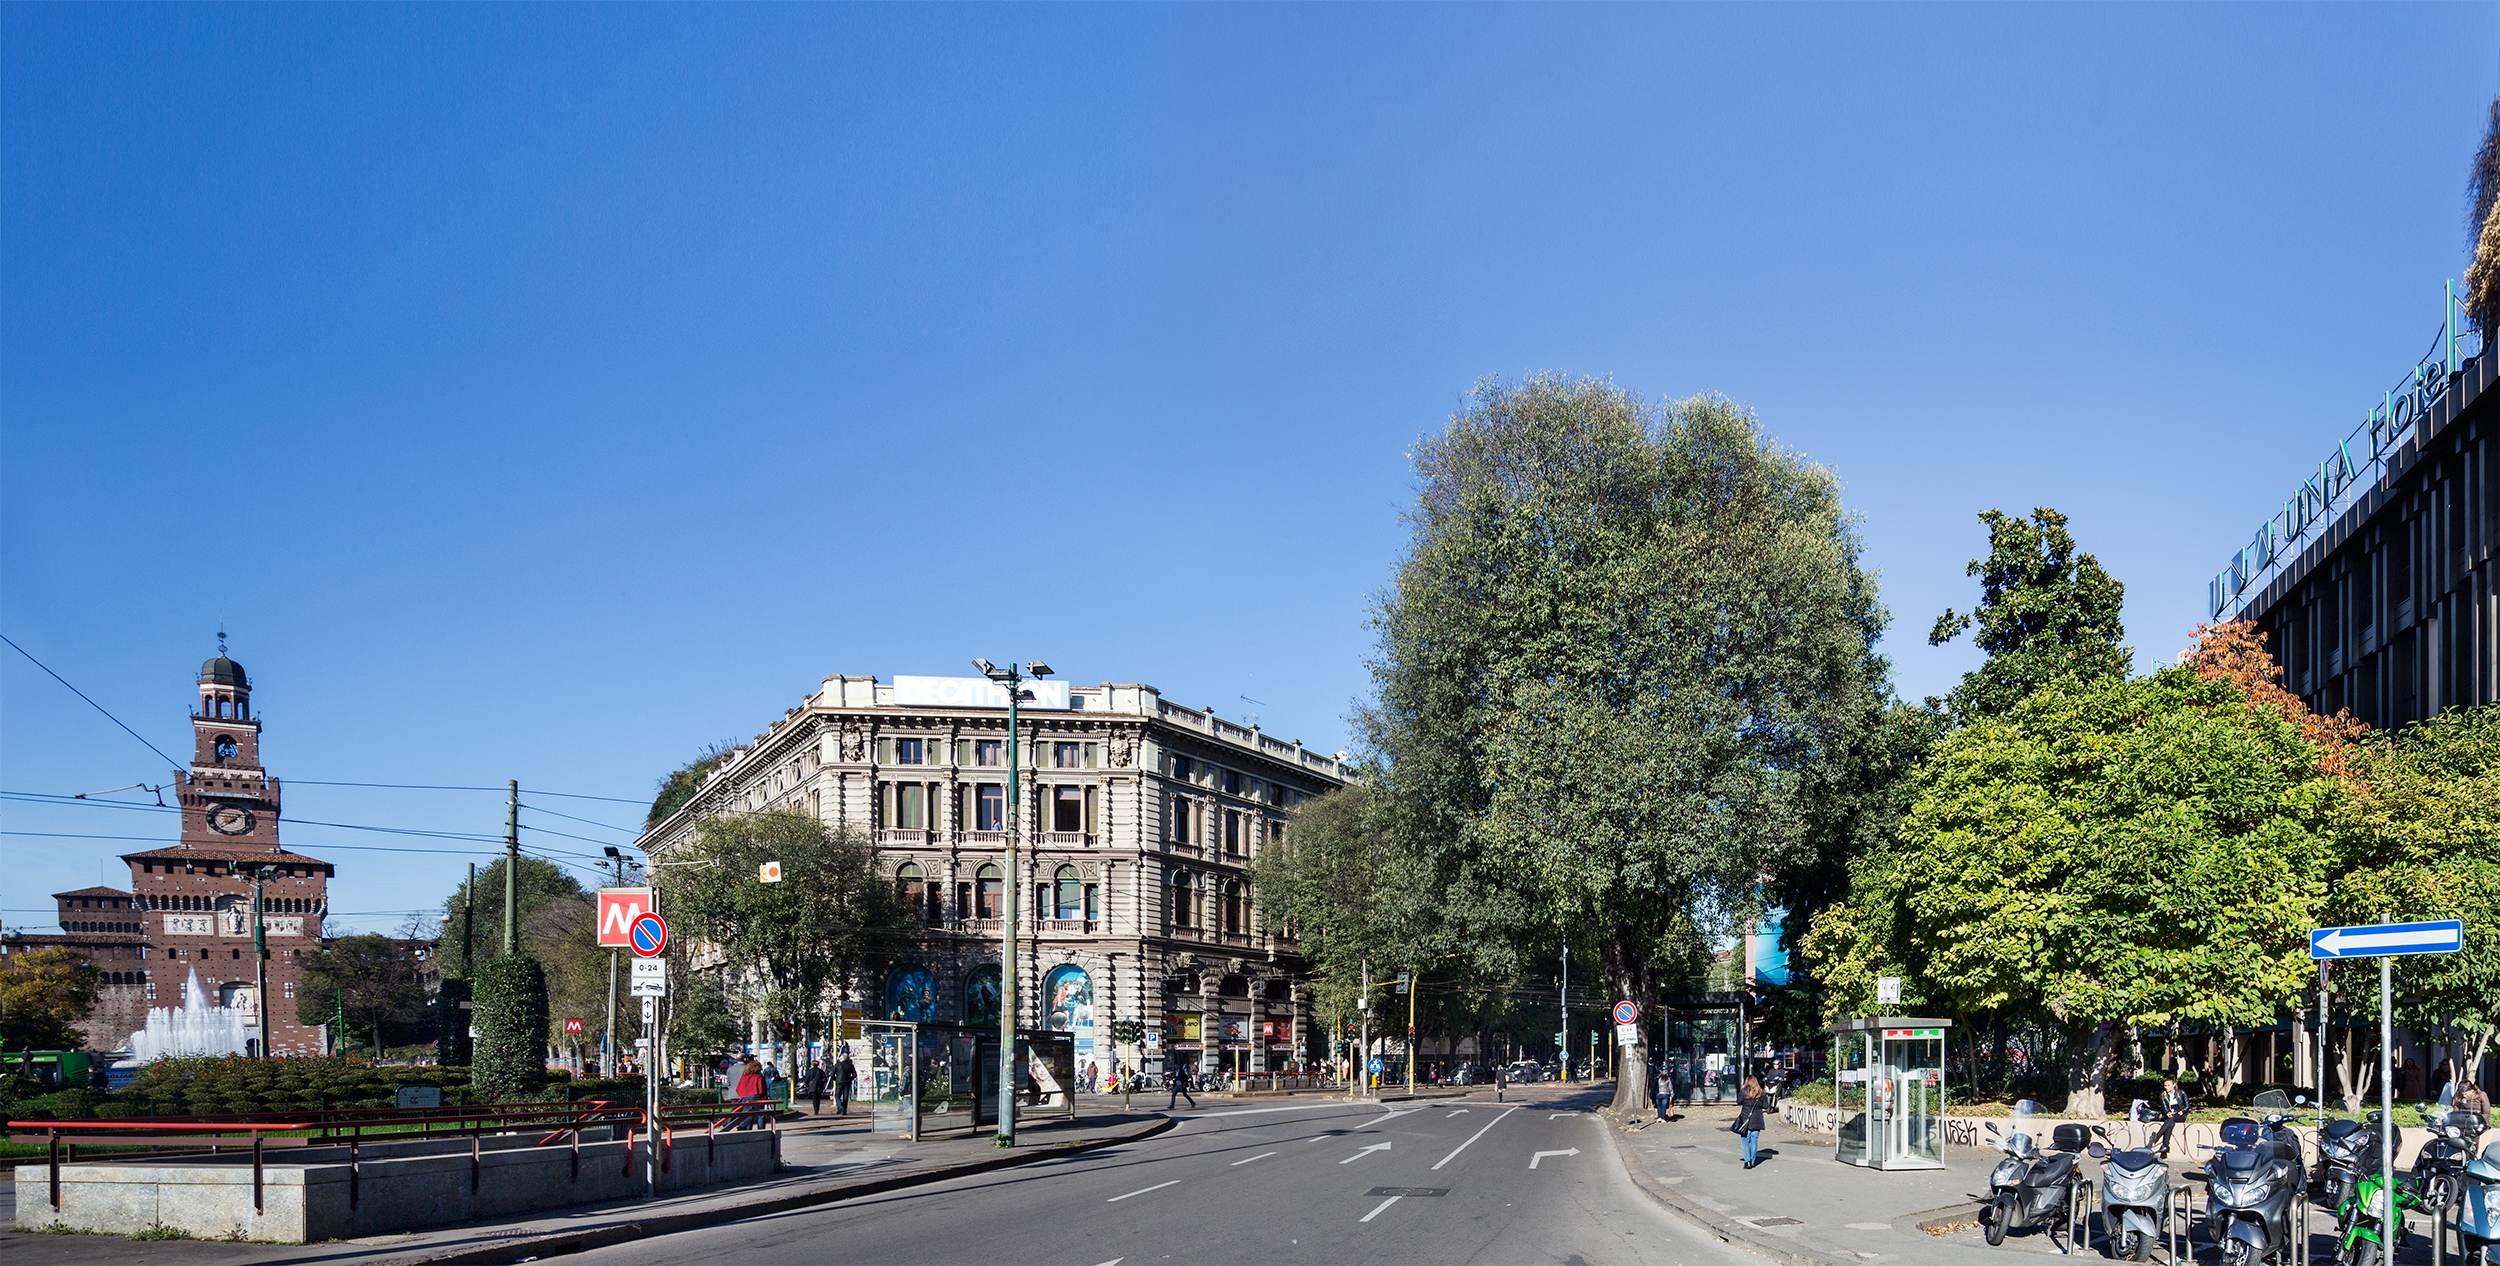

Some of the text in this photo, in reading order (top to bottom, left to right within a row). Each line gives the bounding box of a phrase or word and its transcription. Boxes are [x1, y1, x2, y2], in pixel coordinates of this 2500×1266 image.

[2283, 438, 2356, 543] UNA
[2368, 278, 2455, 460] Hotel
[901, 678, 1062, 707] DECATHON
[602, 902, 641, 934] M
[639, 964, 658, 972] 0-24
[567, 1021, 581, 1031] M
[1264, 1025, 1273, 1033] M
